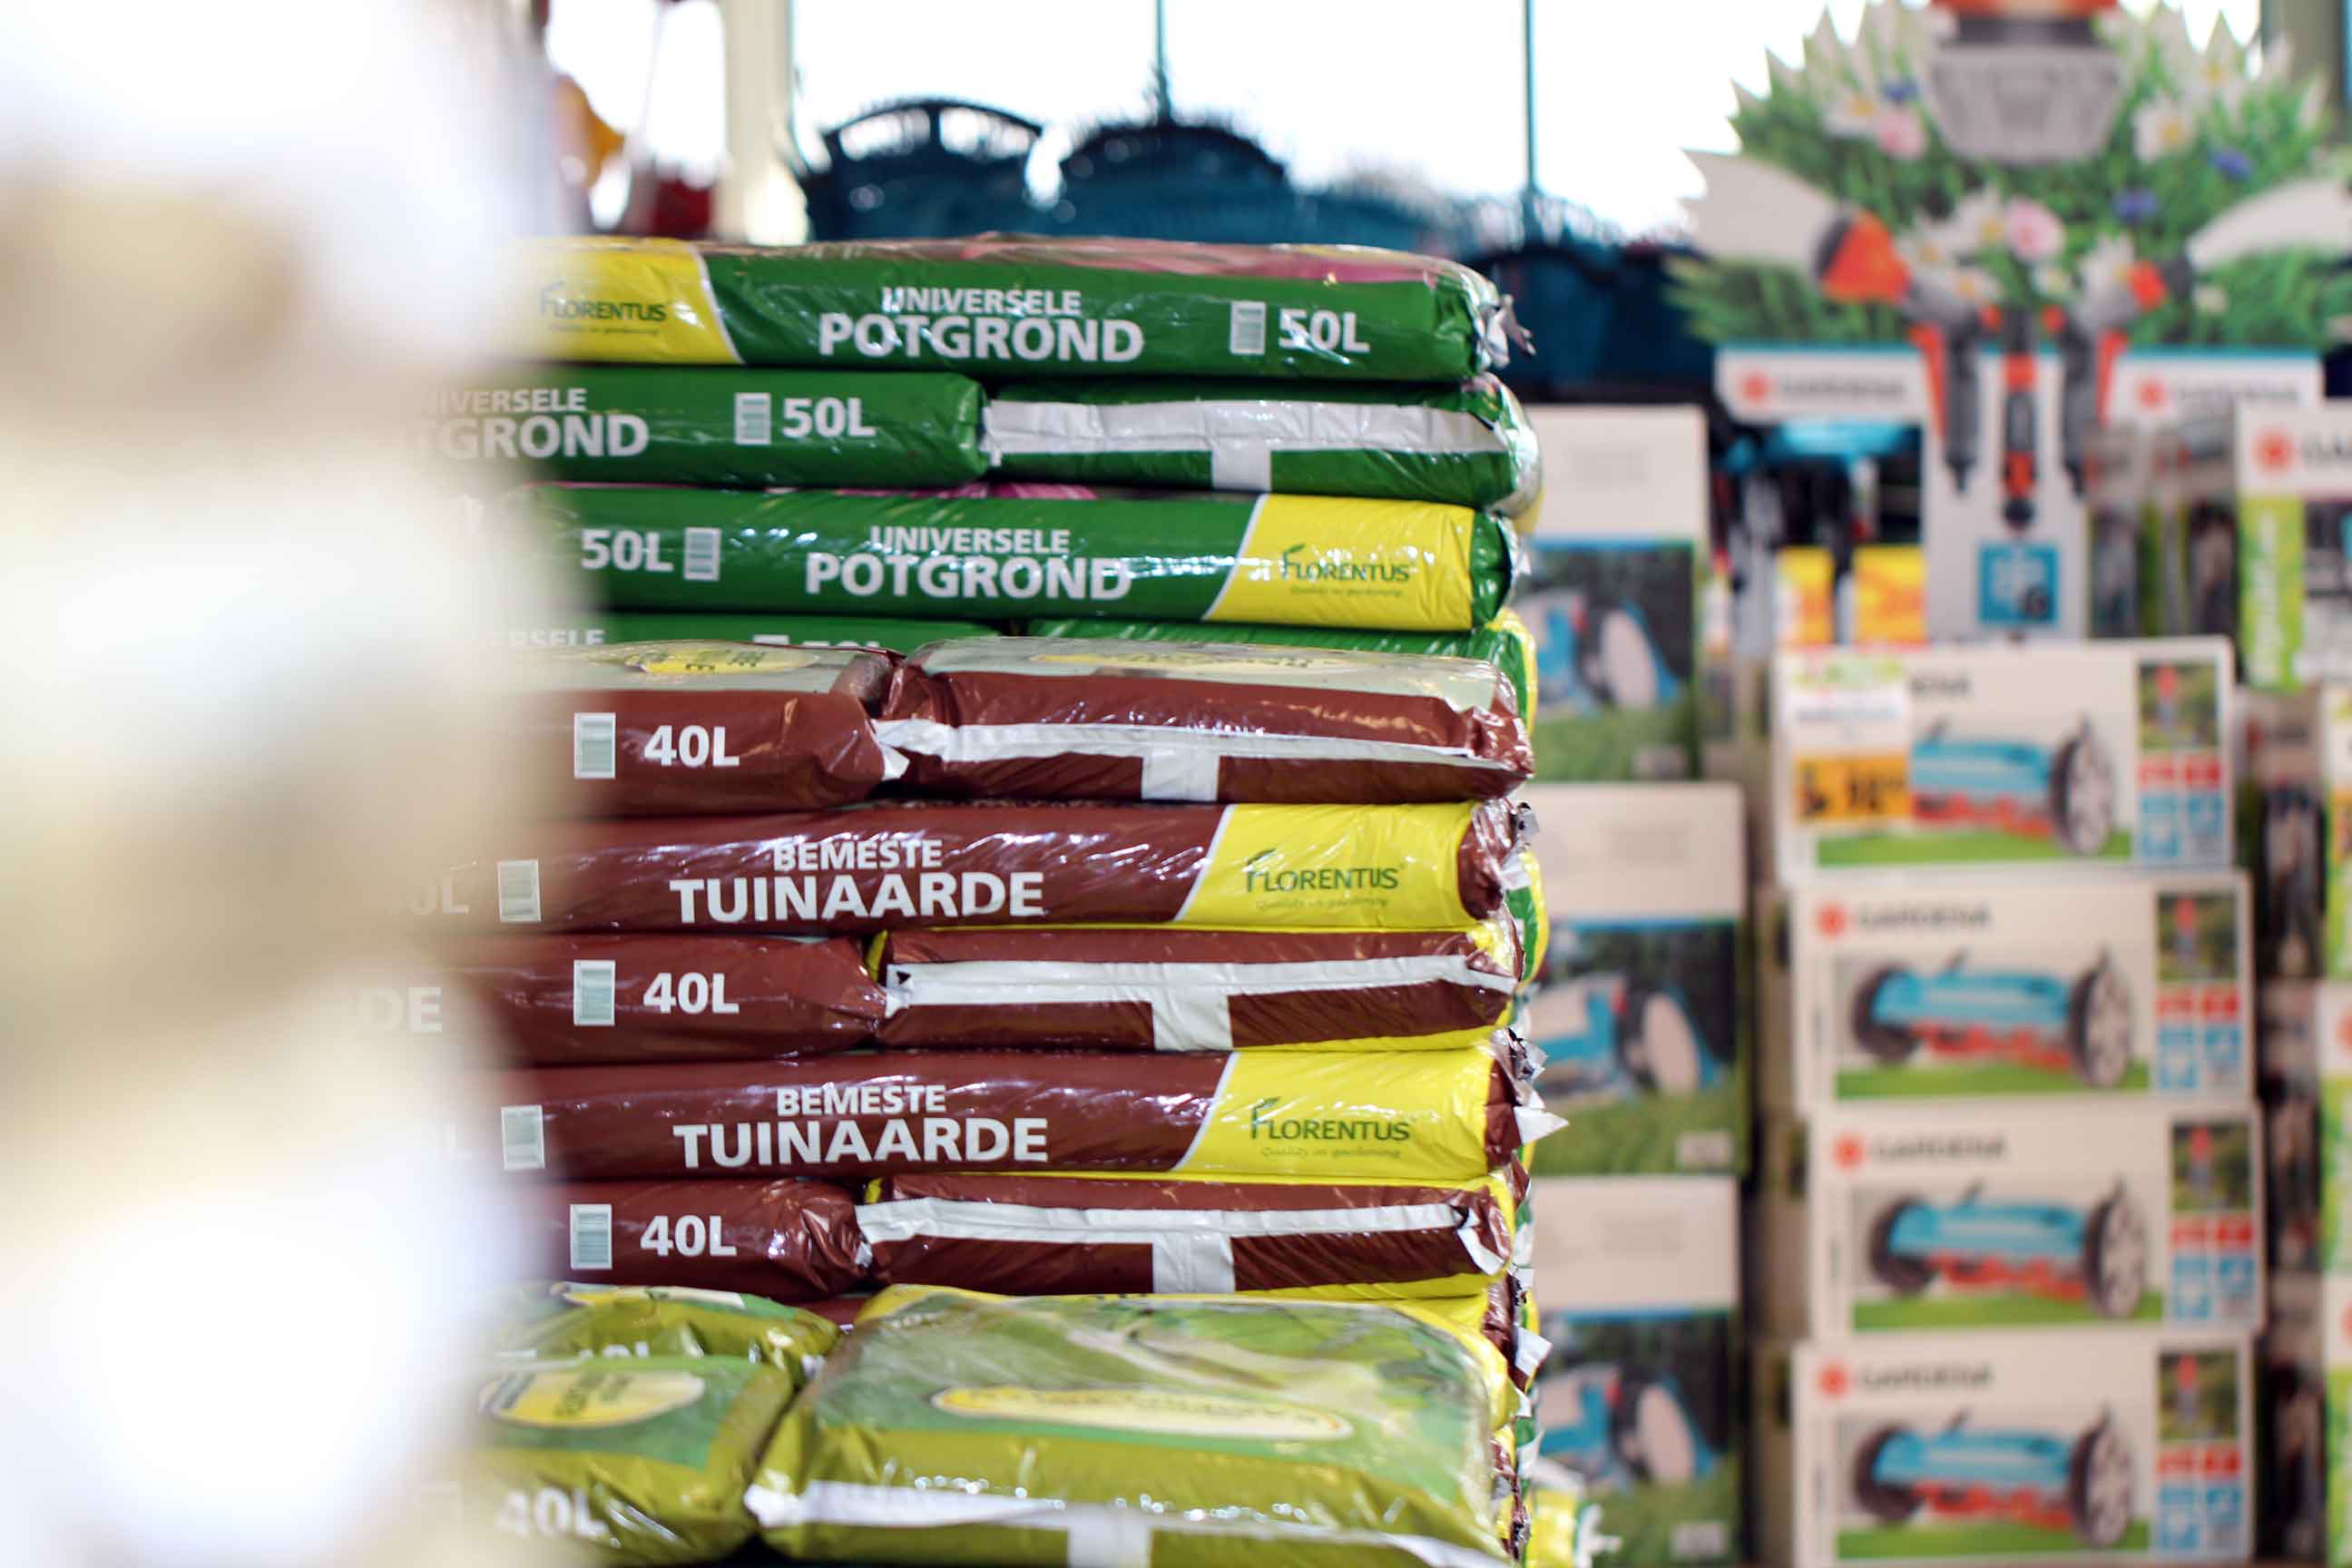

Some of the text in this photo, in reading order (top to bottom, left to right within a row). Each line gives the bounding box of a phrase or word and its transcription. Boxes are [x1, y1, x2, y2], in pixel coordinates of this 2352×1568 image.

[881, 287, 1082, 316] UNIVERSELE
[818, 312, 1145, 362] POTGROND
[1279, 308, 1370, 353] 50L
[782, 397, 877, 438] 50L
[579, 529, 674, 572] 50L
[869, 526, 1072, 554] UNIVERSELE
[806, 552, 1132, 600] POTGROND
[1280, 543, 1410, 582] FLORENTUS
[642, 725, 740, 768] 40L
[772, 839, 943, 872] BEMESTE
[1244, 848, 1400, 893] FLORENTUS
[669, 872, 1045, 925] TUINAARDE
[642, 972, 740, 1014] 40L
[775, 1084, 947, 1117] BEMESTE
[1250, 1095, 1411, 1142] FLORENTUS
[671, 1117, 1049, 1169] TUINAARDE
[639, 1214, 738, 1257] 40L
